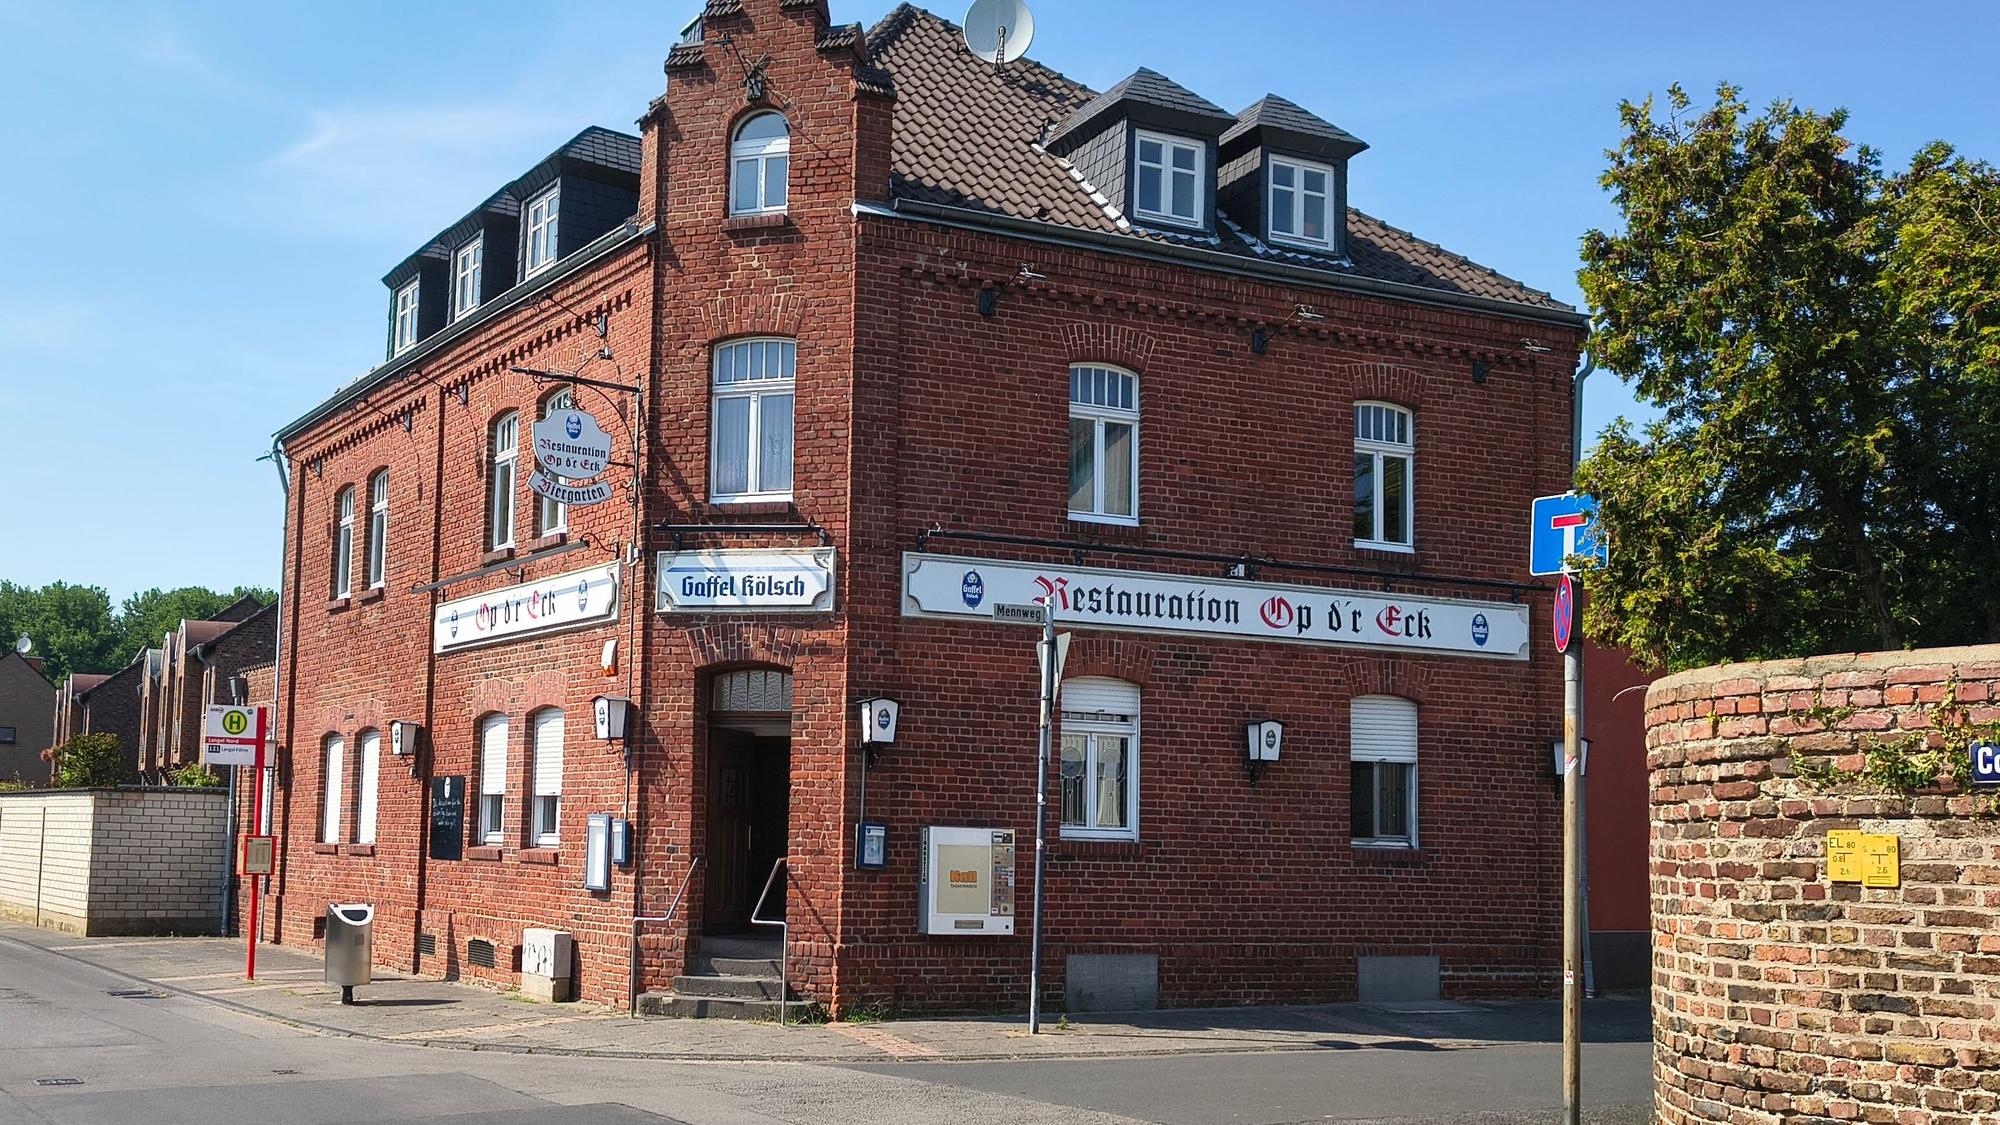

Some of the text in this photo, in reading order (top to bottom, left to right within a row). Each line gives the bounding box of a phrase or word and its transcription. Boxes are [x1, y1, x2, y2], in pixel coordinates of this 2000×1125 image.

[540, 438, 606, 458] Restauration
[544, 454, 562, 467] Op
[580, 459, 601, 472] Eck
[537, 478, 606, 503] Biergarten
[681, 575, 805, 598] Gaffel Kölsch
[963, 584, 982, 594] Gaffel
[475, 602, 497, 632] Op
[527, 589, 556, 619] Eck
[997, 604, 1041, 621] Mennweg
[1032, 575, 1240, 625] Restauration
[1260, 596, 1312, 635] Op
[1376, 603, 1432, 640] Eck
[1829, 837, 1856, 849] EL 80
[1886, 845, 1897, 854] 80
